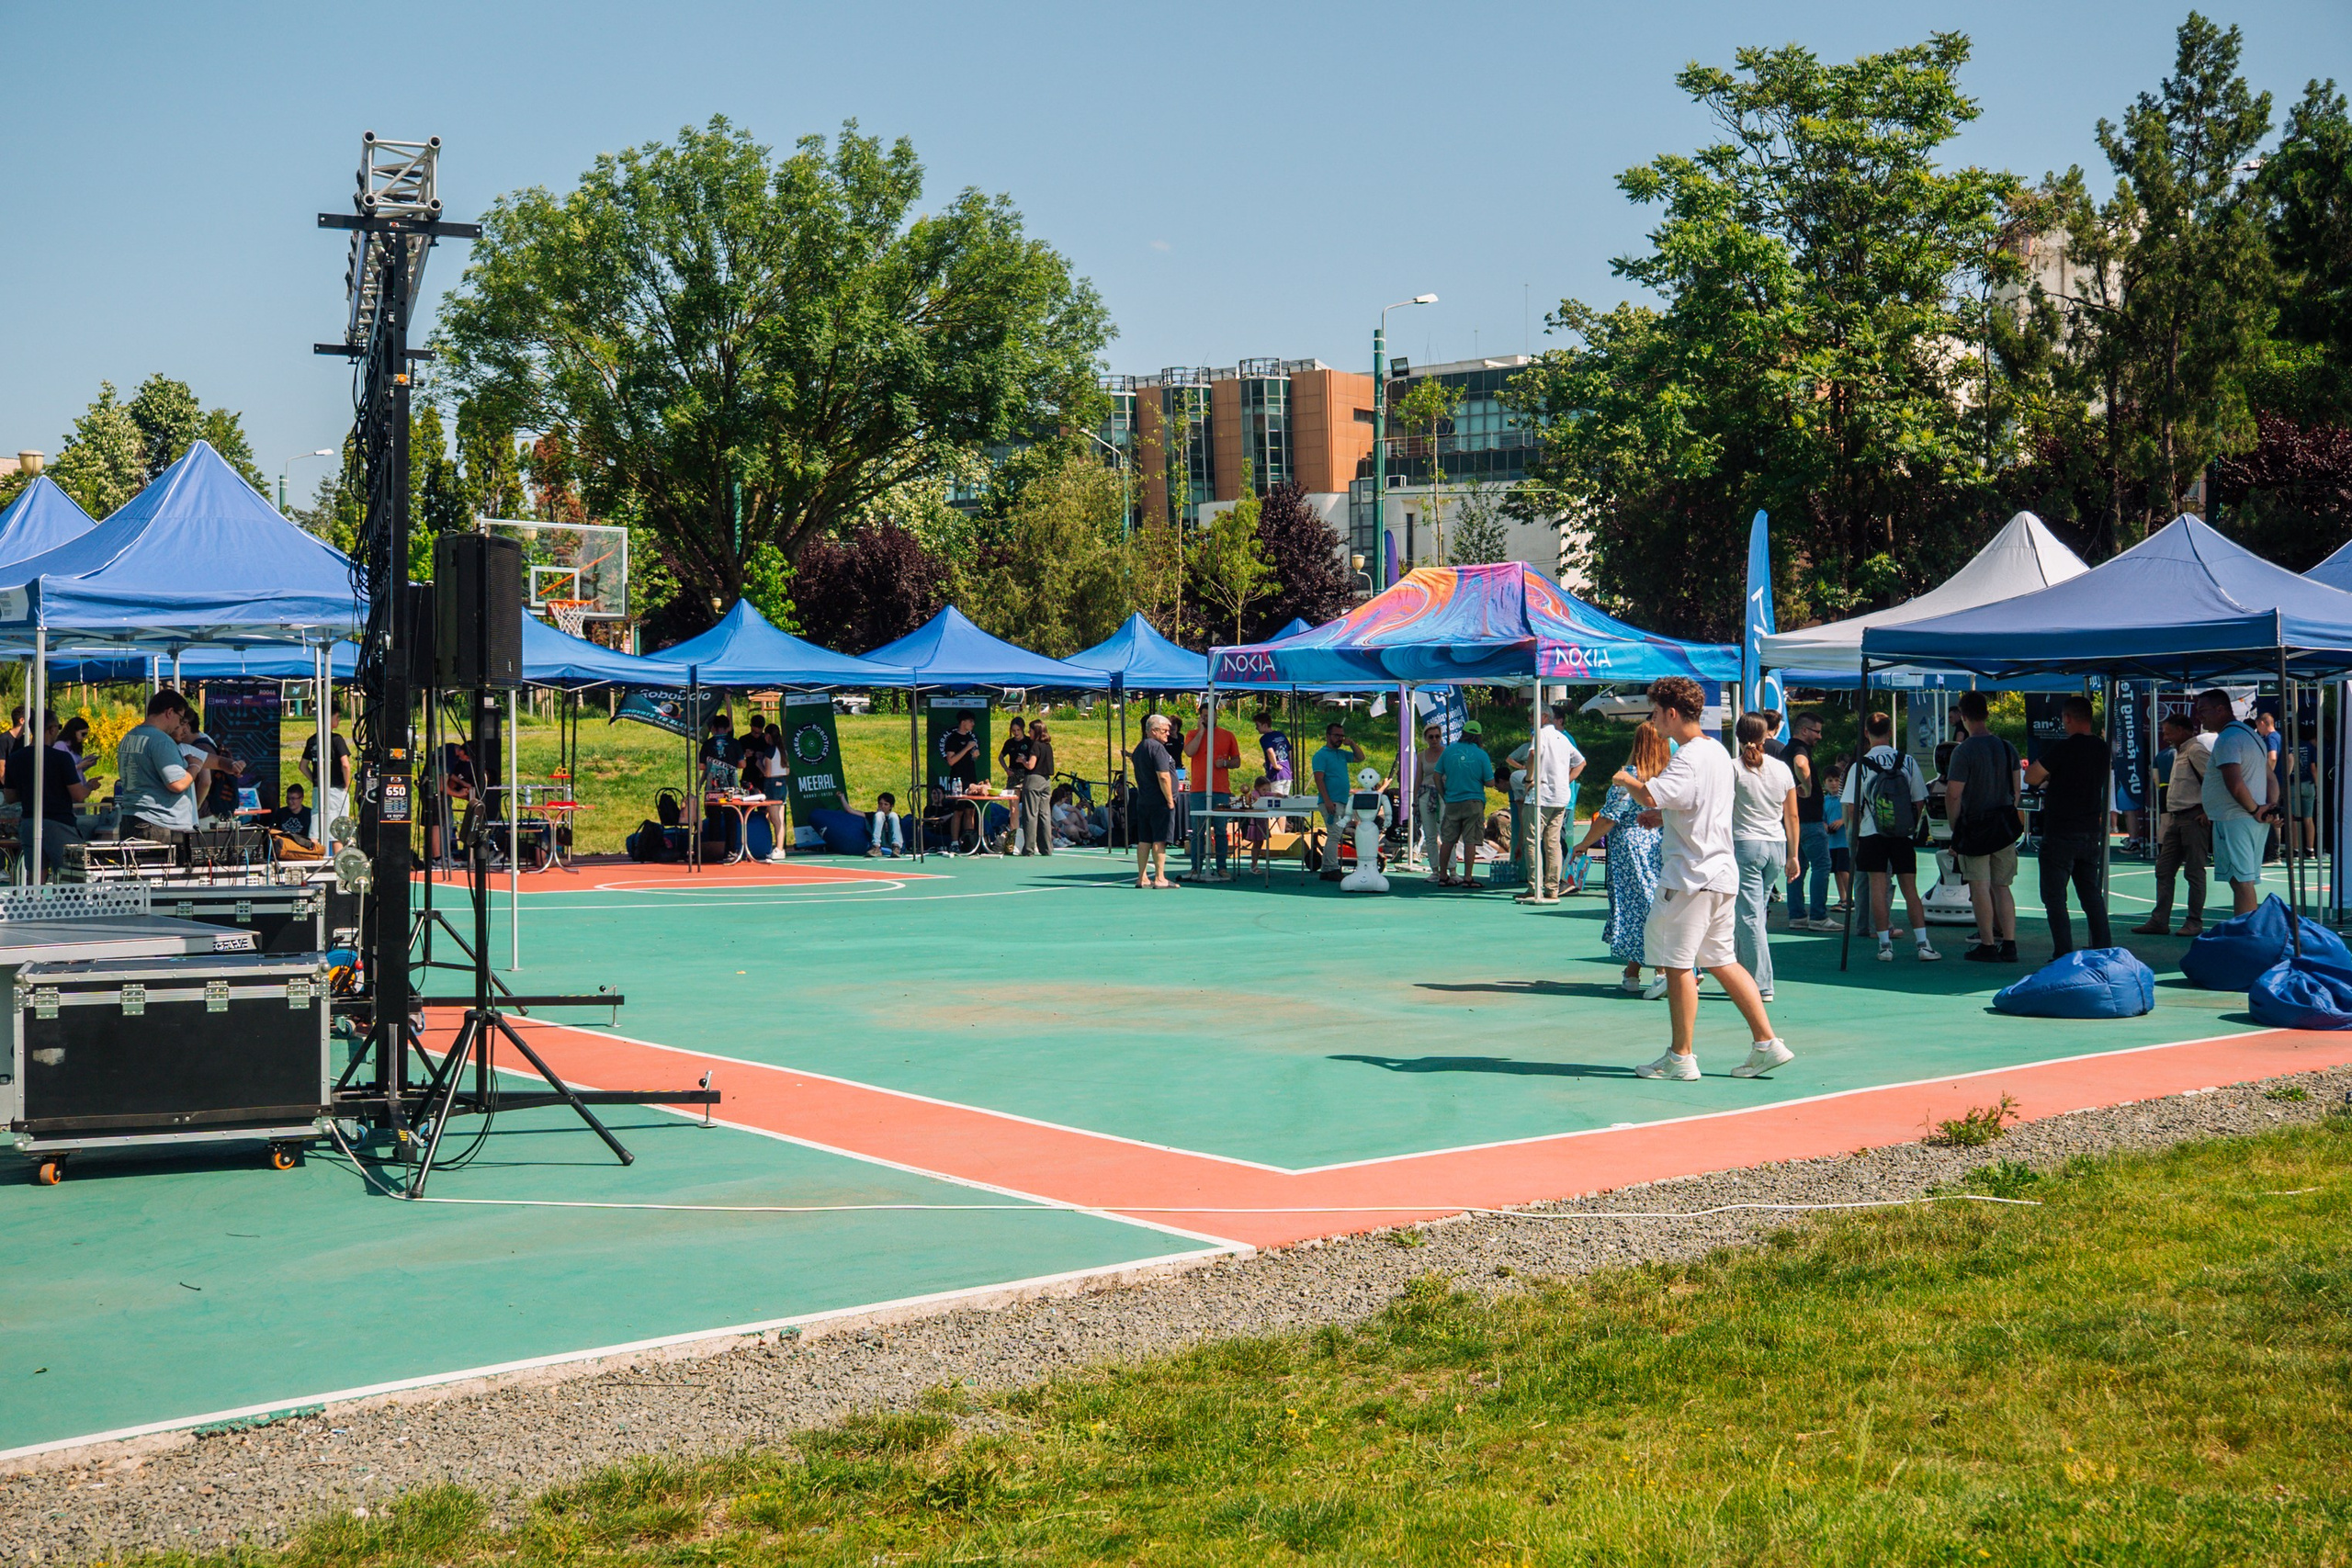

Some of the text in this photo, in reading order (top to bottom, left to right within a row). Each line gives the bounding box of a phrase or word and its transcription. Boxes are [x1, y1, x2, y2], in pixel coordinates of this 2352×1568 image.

[1224, 654, 1276, 672] NOKIA
[1555, 647, 1612, 667] NOKIA
[793, 728, 805, 758] MEERAL
[812, 724, 830, 757] ROBOTICS
[386, 786, 406, 796] 650
[797, 773, 837, 793] MEERAL
